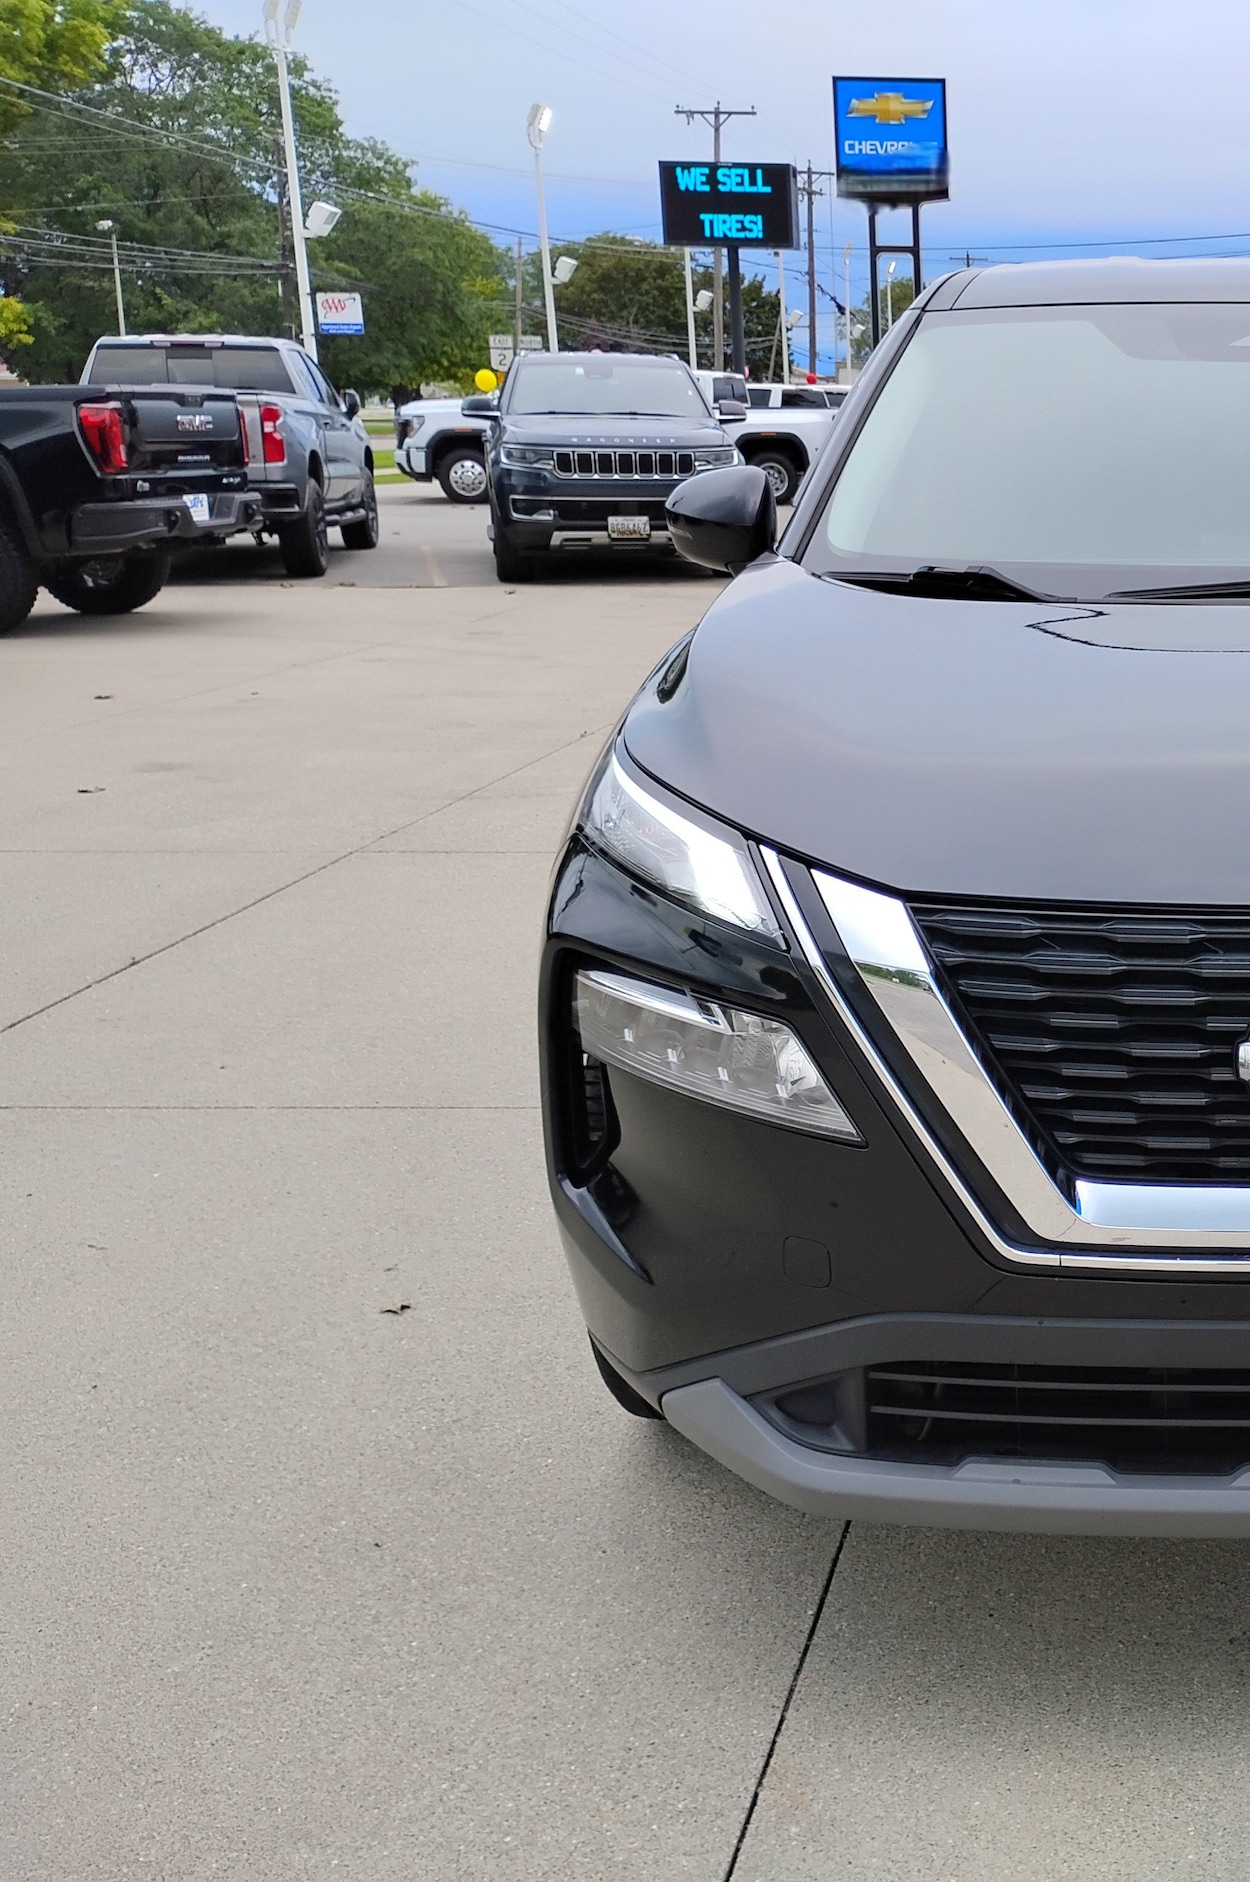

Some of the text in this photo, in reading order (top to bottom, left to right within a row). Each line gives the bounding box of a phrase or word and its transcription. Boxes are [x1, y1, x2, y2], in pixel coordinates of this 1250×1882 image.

[675, 166, 772, 193] WE SELL
[699, 213, 763, 239] TIRES!
[321, 298, 346, 313] AAA
[493, 337, 509, 345] EAST
[498, 353, 507, 367] 2
